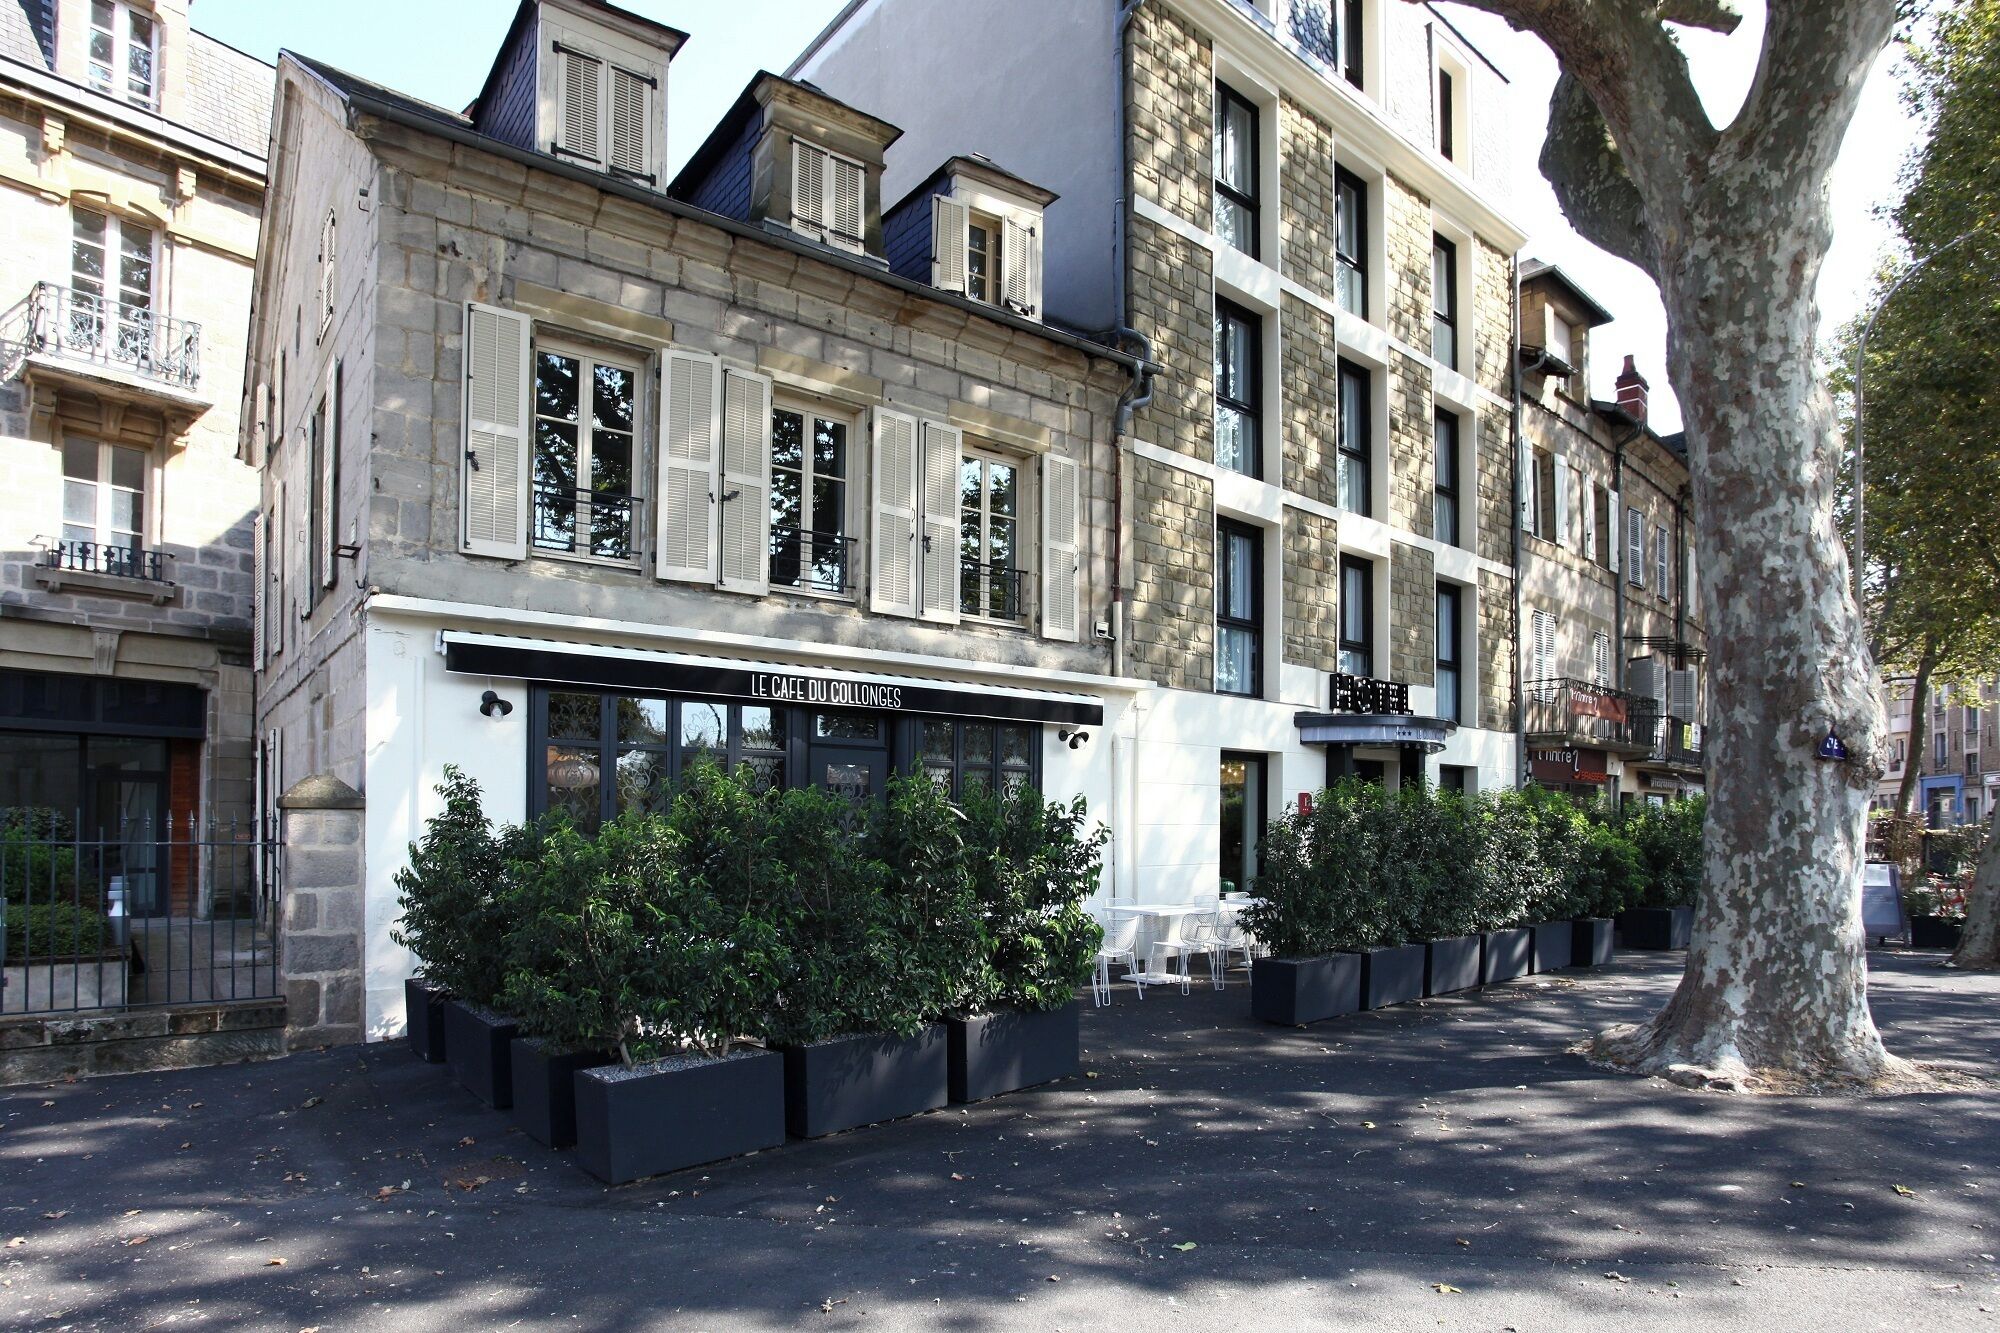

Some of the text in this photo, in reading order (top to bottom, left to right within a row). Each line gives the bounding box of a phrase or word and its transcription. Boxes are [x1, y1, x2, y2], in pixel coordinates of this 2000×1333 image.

[751, 674, 901, 708] LE CAFE DU COLLONGES
[1330, 673, 1413, 715] HOTEL
